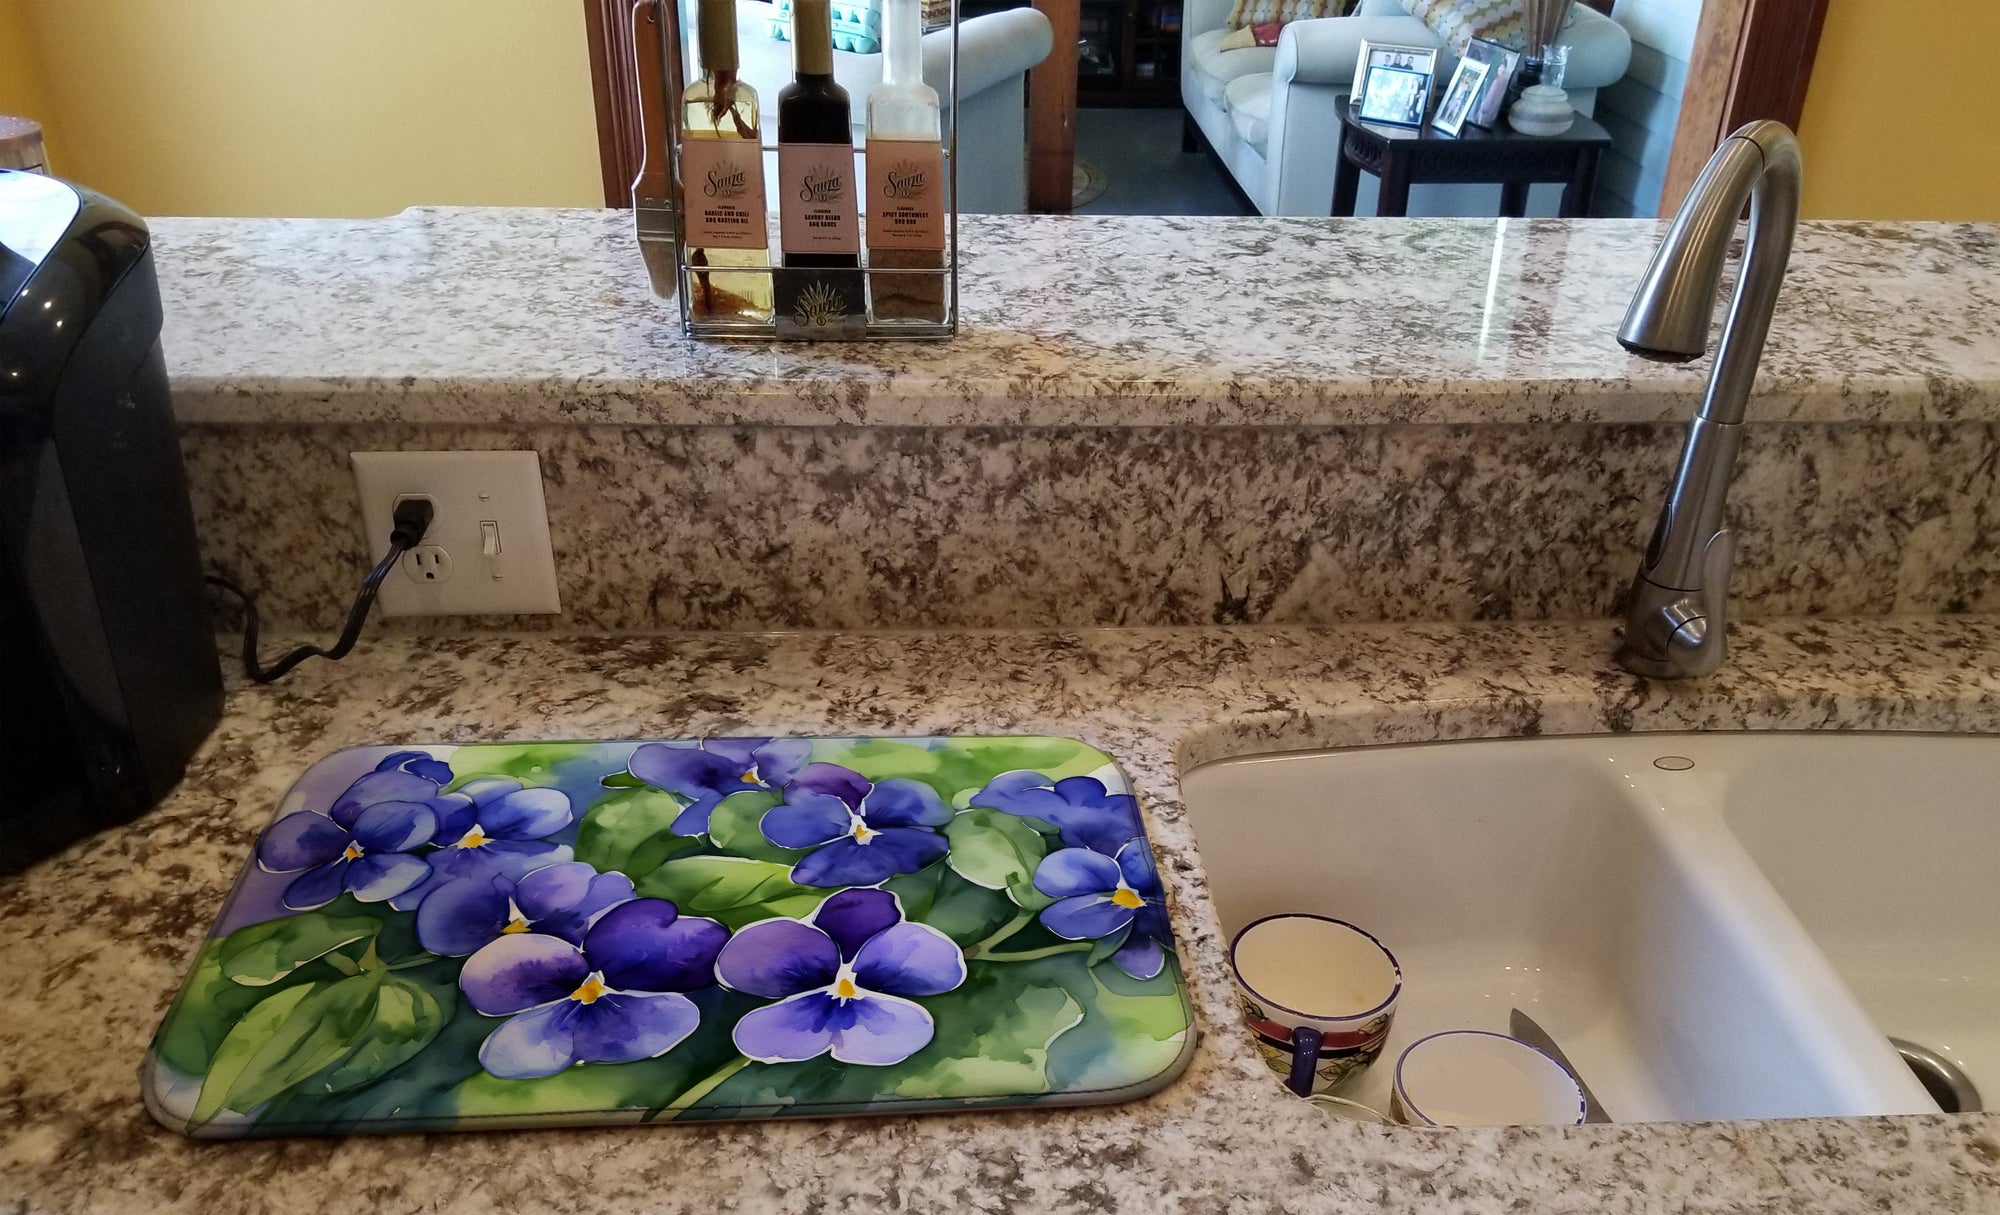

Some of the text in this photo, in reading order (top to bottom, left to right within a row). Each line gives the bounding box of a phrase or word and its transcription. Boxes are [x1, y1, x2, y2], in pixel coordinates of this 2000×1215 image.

[704, 170, 746, 197] Sauza
[800, 175, 842, 202] Sauza
[884, 171, 926, 198] Sauza
[793, 296, 844, 327] Sauza
